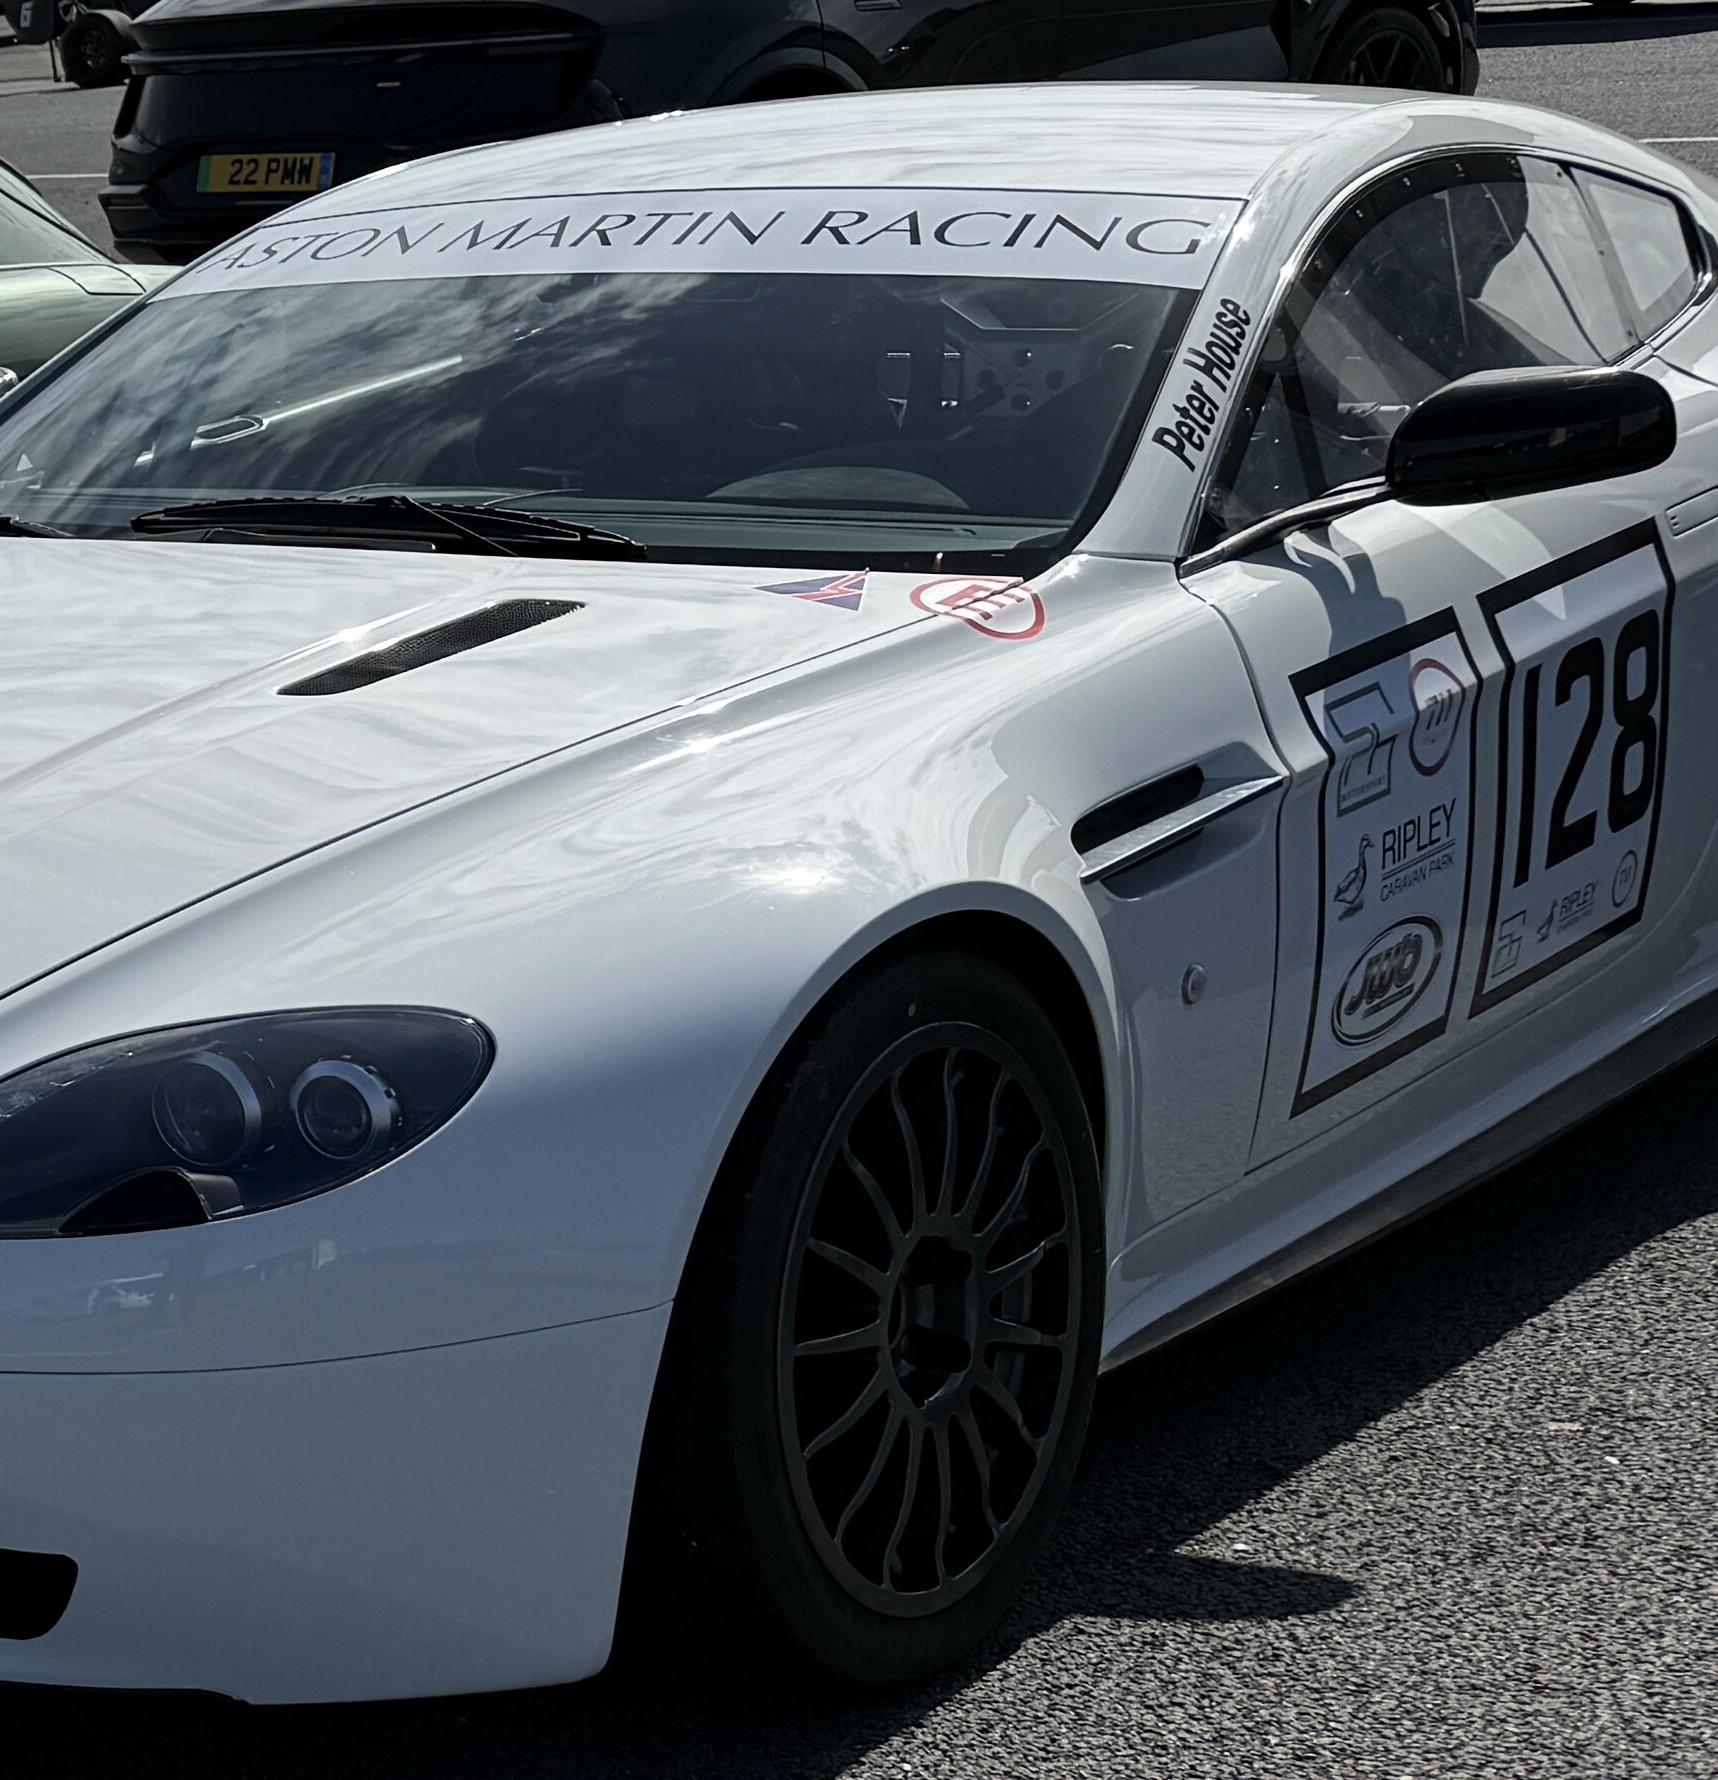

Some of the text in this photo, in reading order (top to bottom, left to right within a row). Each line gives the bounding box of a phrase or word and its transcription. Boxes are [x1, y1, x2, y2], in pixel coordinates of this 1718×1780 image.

[228, 157, 315, 185] 22 PMW
[196, 210, 1212, 275] ASTON MARTIN RACING
[1151, 297, 1252, 473] Peter House
[1513, 608, 1660, 889] 128
[1381, 796, 1457, 871] RIPLEY
